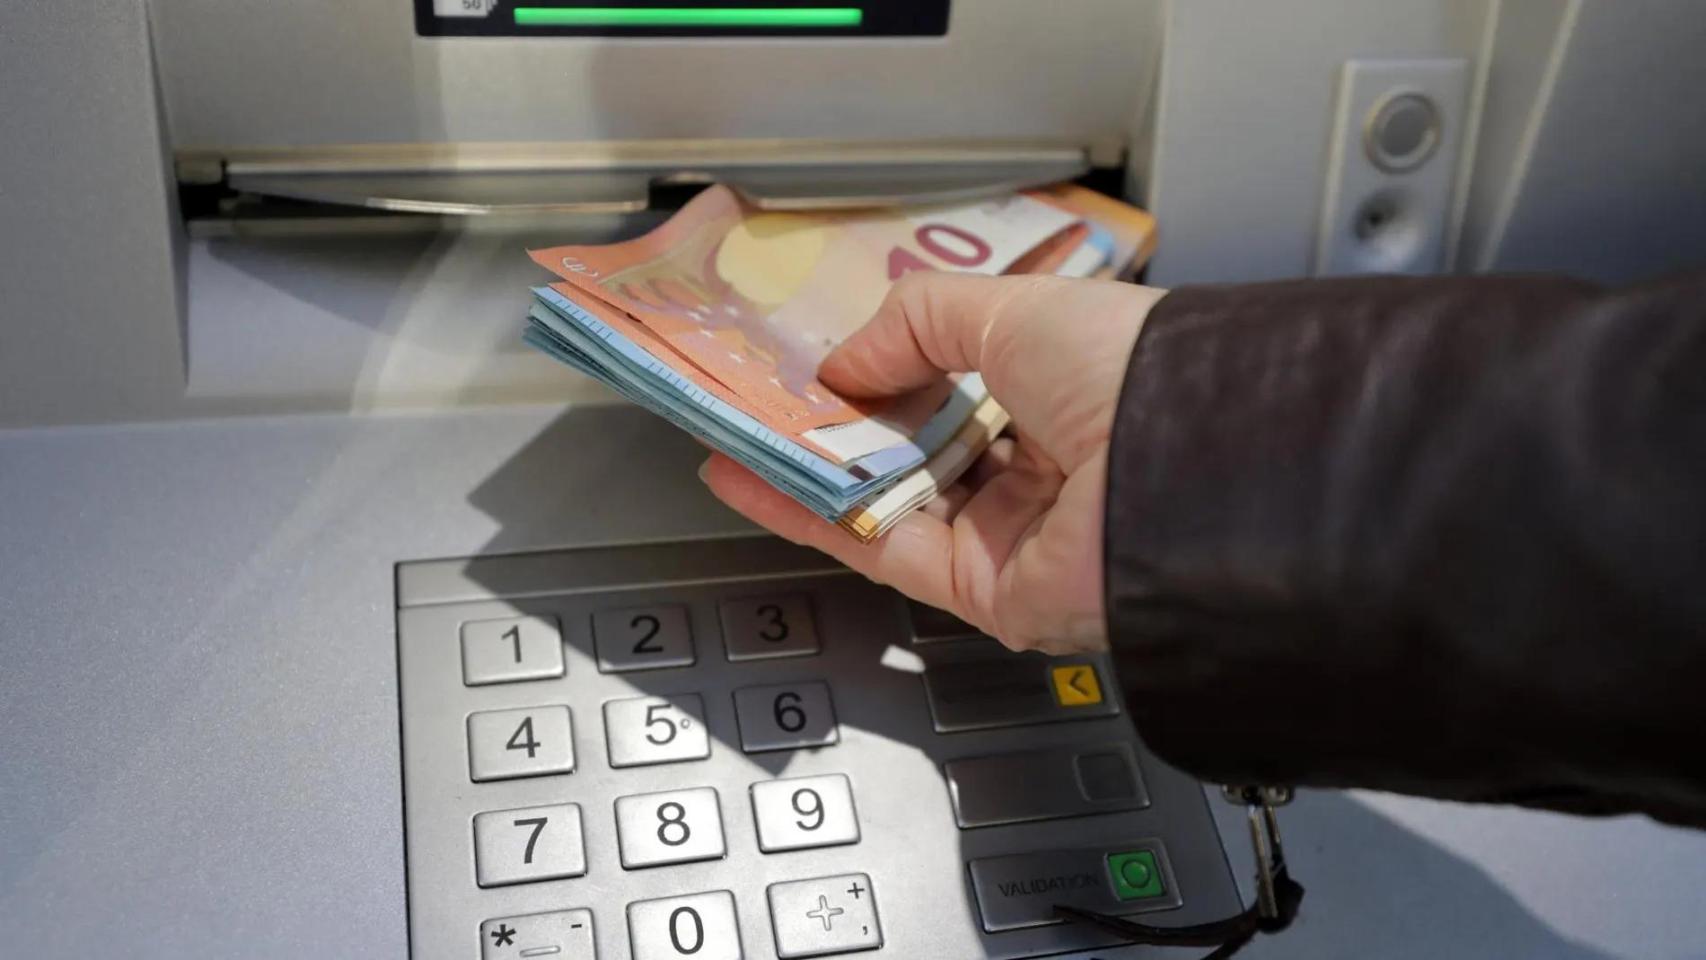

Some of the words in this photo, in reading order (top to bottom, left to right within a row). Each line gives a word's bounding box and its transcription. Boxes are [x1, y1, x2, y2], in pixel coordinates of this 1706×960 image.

[630, 615, 663, 654] 2
[757, 604, 789, 642] 3
[500, 625, 523, 664] 1
[645, 704, 677, 745] 5
[773, 692, 807, 732] 6
[506, 717, 541, 758] 4
[656, 801, 691, 846] 8
[791, 788, 825, 831] 9
[513, 817, 549, 864] 7
[998, 872, 1099, 897] VALIDATION
[668, 906, 704, 955] 0
